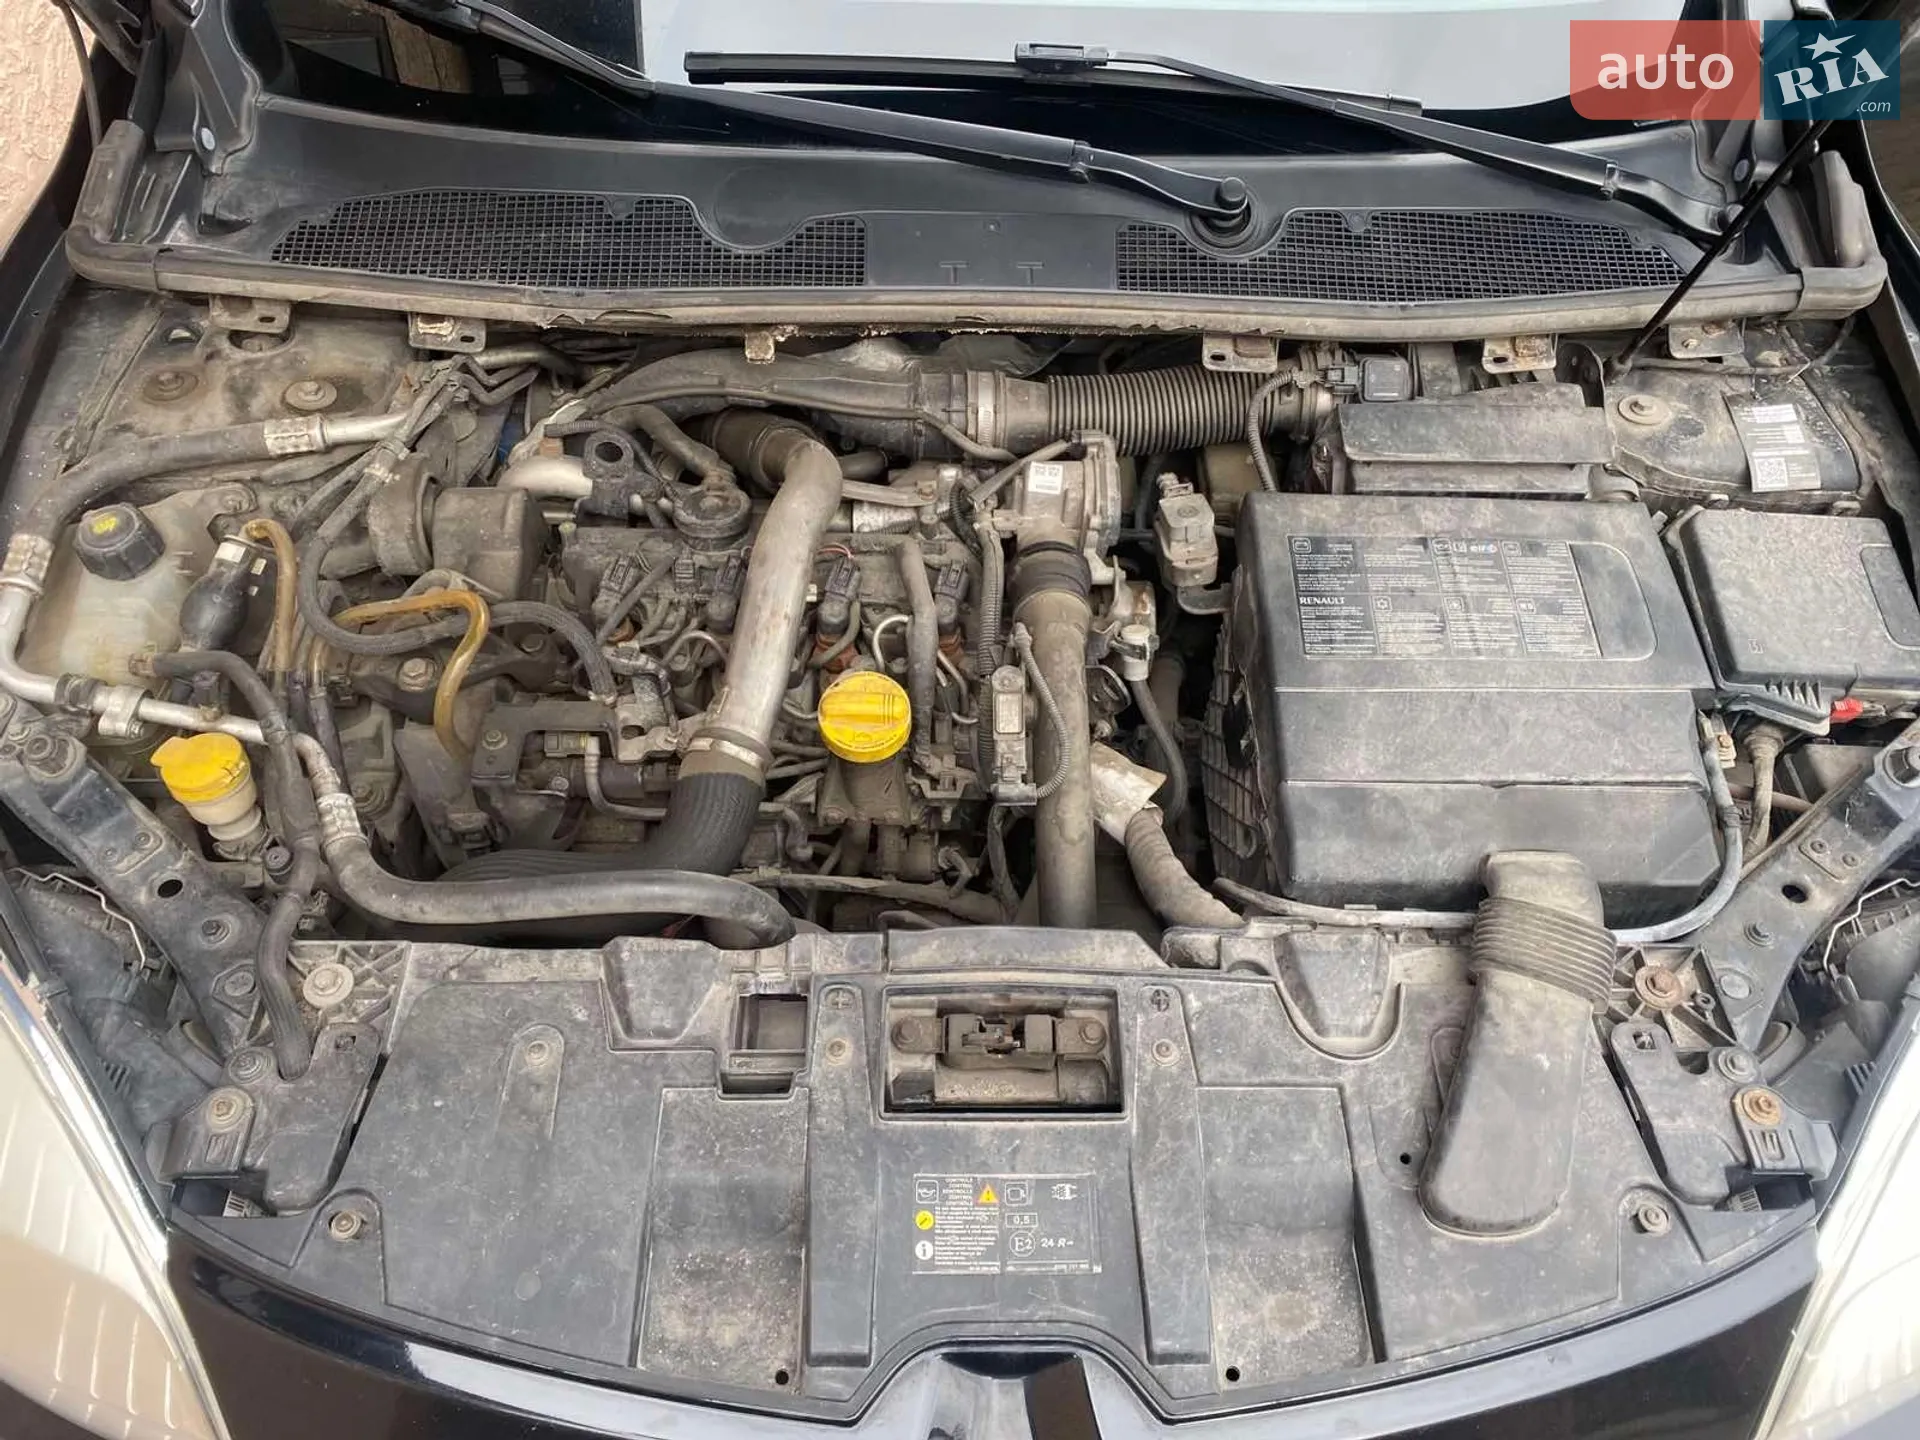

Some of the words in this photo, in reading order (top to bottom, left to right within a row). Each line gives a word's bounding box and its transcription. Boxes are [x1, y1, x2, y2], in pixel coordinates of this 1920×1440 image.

[1299, 596, 1345, 605] RENAULT
[1014, 1237, 1033, 1252] E2
[1040, 1237, 1055, 1248] 24
